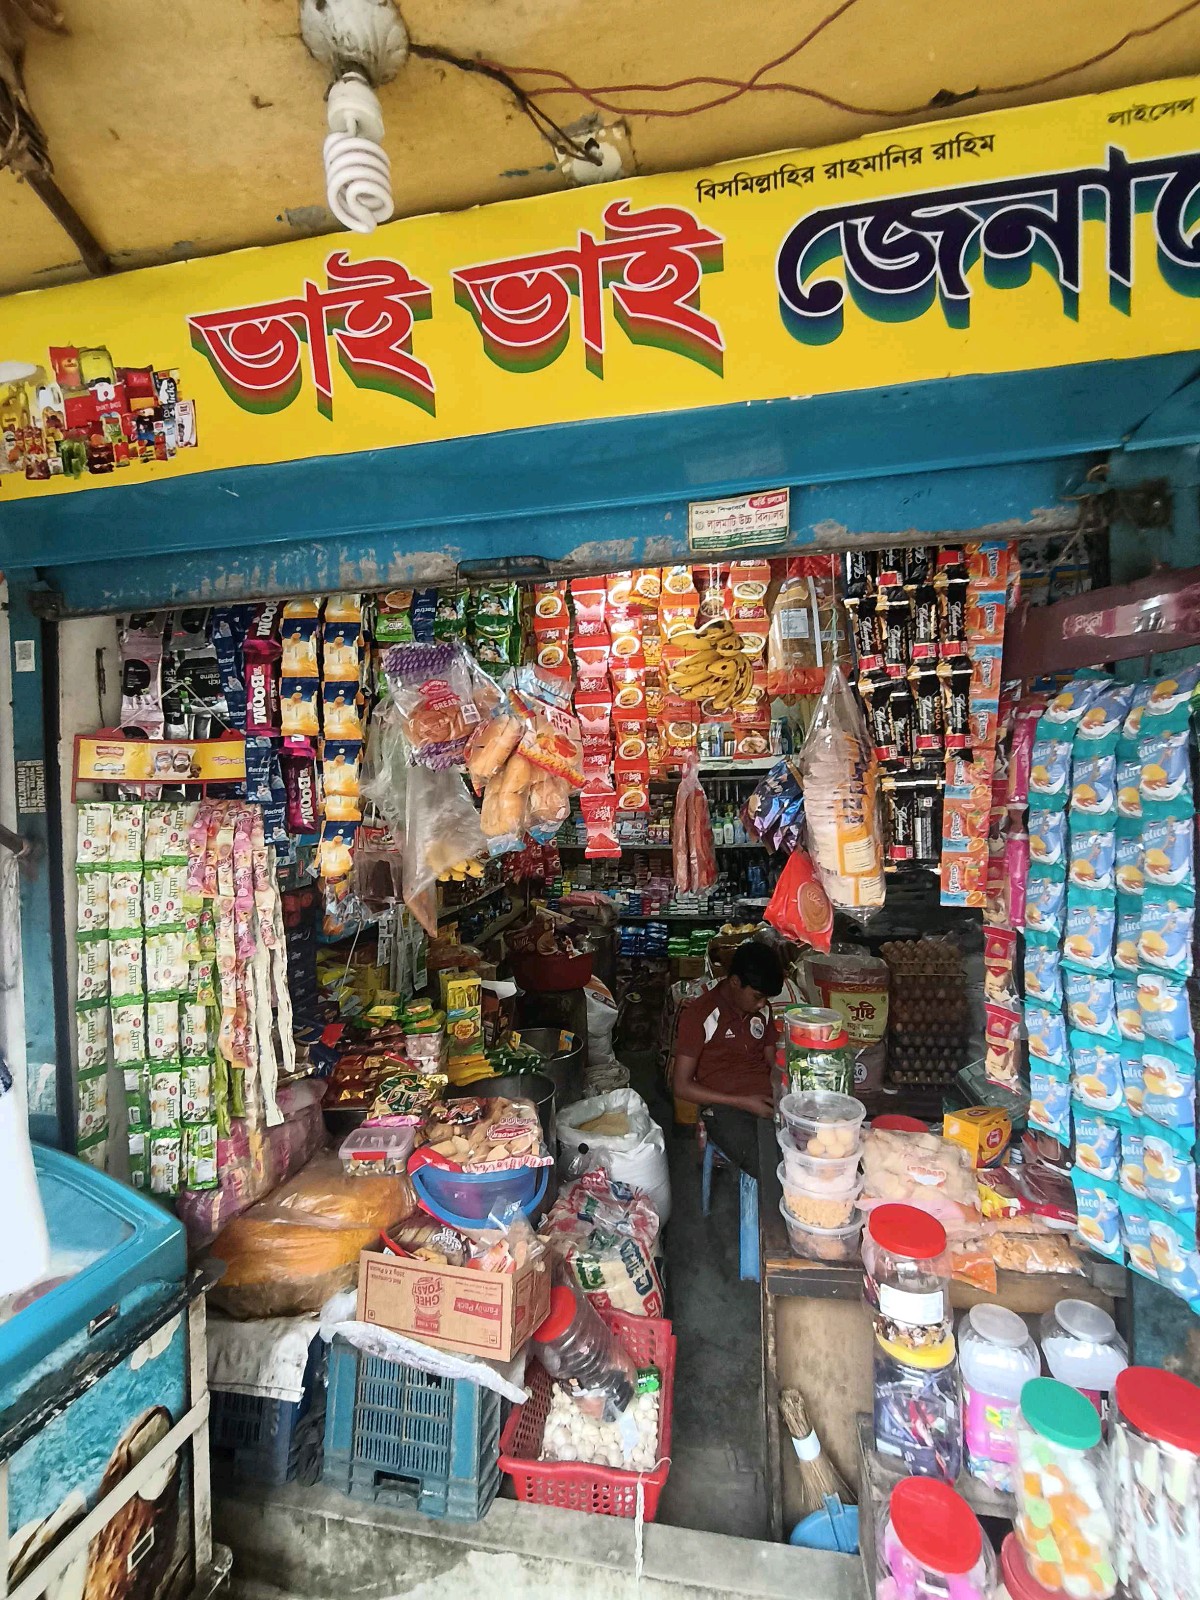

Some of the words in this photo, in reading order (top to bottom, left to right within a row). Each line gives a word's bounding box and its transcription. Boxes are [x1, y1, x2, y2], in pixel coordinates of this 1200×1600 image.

[695, 163, 816, 204] বিসমিল্লাহির
[823, 145, 924, 181] রাহমানির
[930, 132, 997, 162] রাহিম
[188, 251, 437, 414] ভাই
[452, 198, 726, 374] ভাই
[433, 699, 458, 711] BREAD
[848, 1001, 877, 1022] পুষ্টি
[412, 1275, 444, 1292] TOAST
[415, 1294, 440, 1308] GHEE
[456, 1300, 474, 1314] Pack
[475, 1303, 499, 1316] Family
